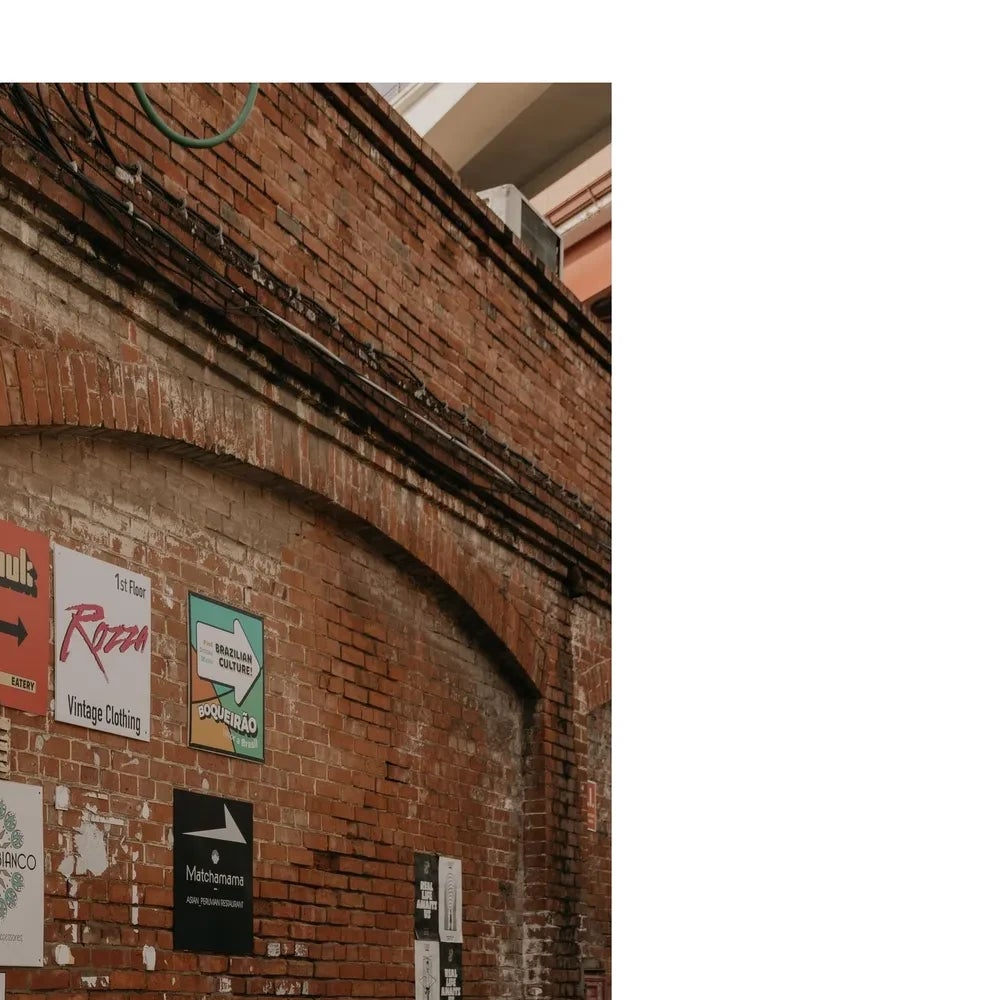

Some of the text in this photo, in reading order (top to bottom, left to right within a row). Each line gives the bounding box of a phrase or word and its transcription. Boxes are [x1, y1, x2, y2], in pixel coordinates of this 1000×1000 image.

[114, 573, 147, 599] 1st Floor
[215, 643, 253, 664] BRAZILIAN
[219, 657, 253, 677] CULTURE!
[11, 676, 35, 691] EATERY
[67, 694, 141, 737] Vintage Clothing
[198, 703, 258, 735] BOQUEIRÃO
[186, 864, 244, 886] Matchamama
